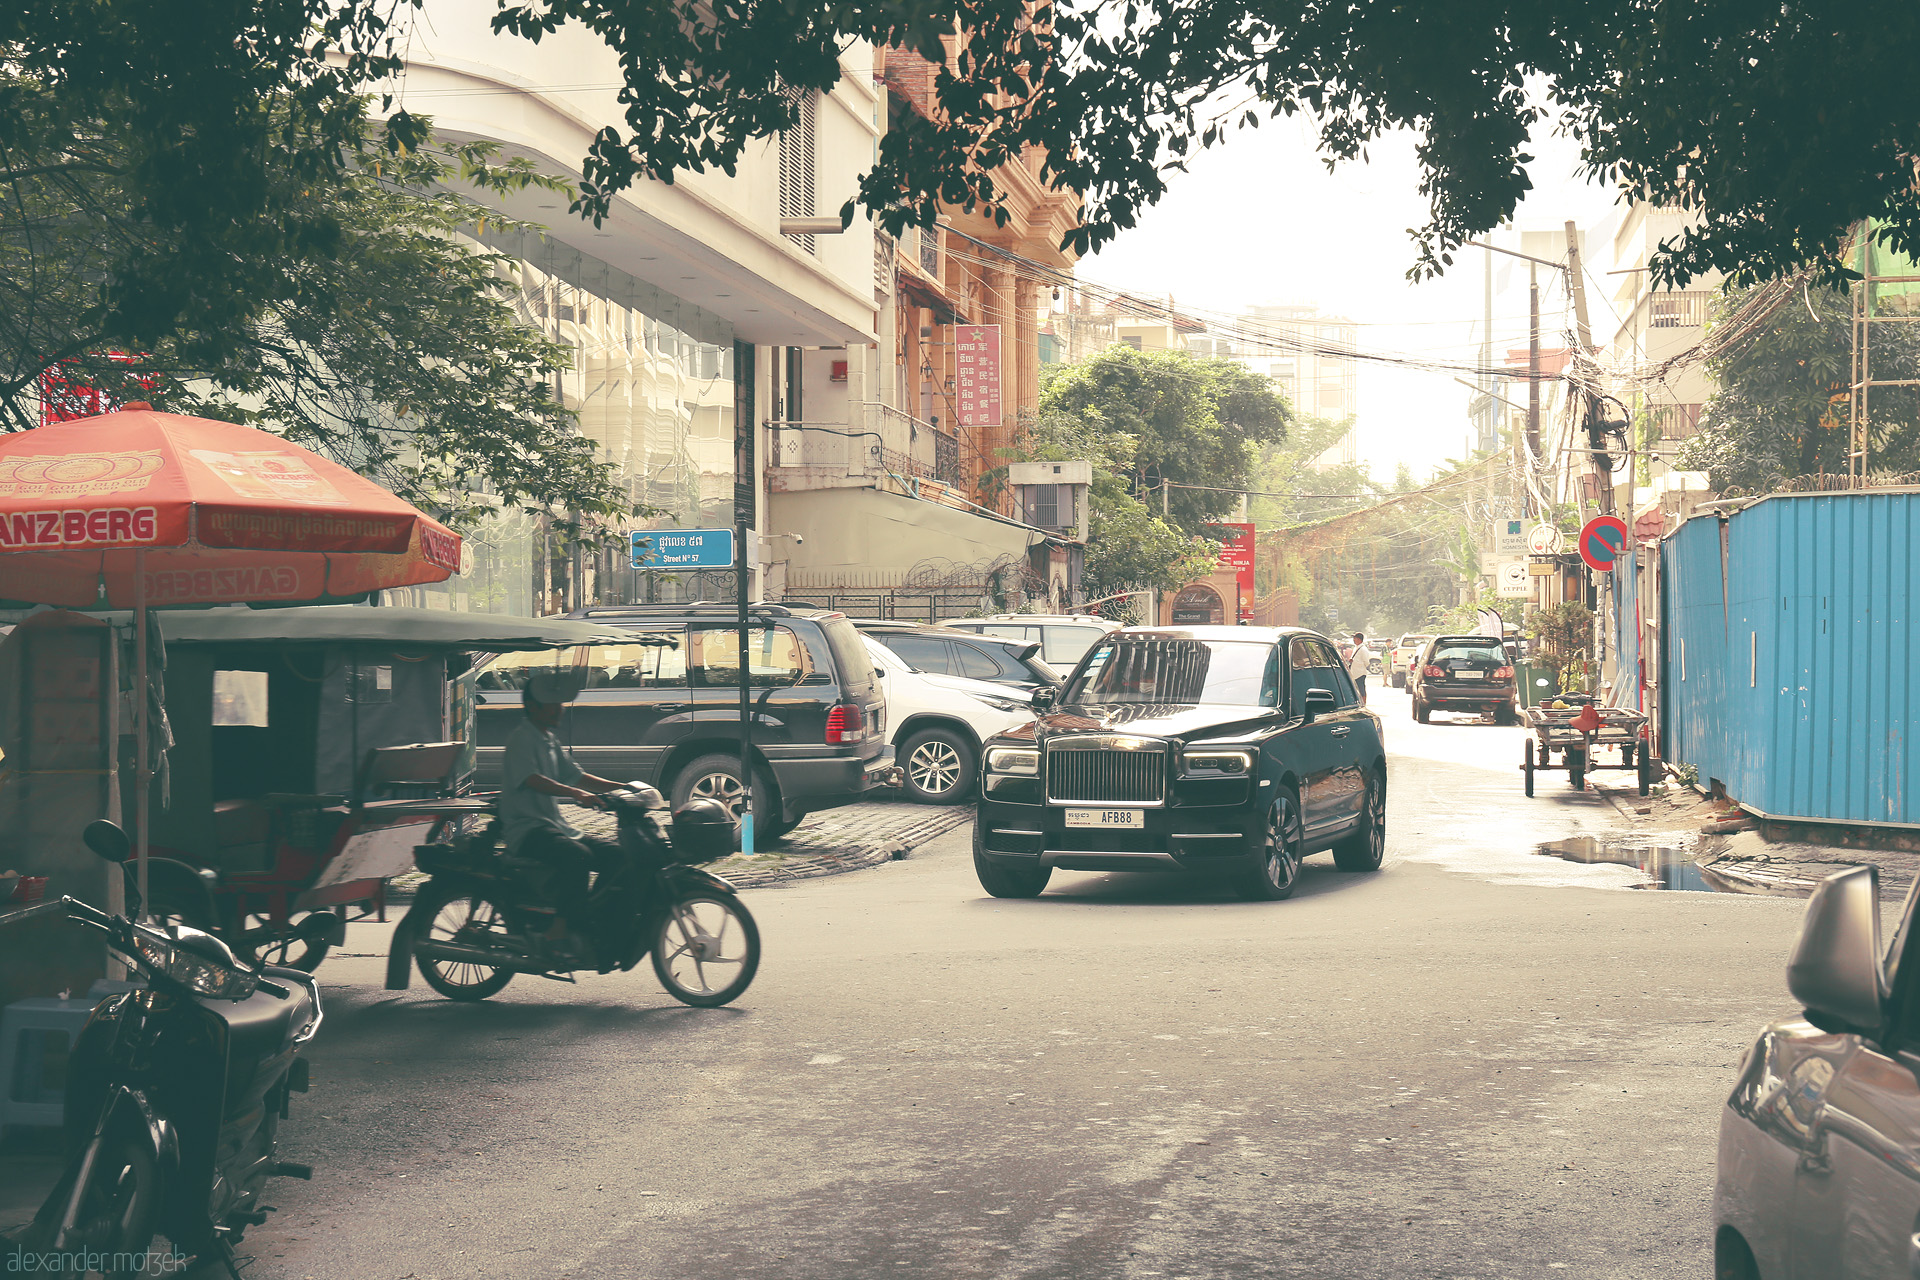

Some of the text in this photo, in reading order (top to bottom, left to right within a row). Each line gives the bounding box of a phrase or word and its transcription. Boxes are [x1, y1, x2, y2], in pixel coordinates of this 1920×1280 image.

[0, 507, 157, 546] ANZBERG
[663, 555, 682, 563] Street
[692, 554, 700, 562] 57
[1101, 811, 1132, 823] AFB88
